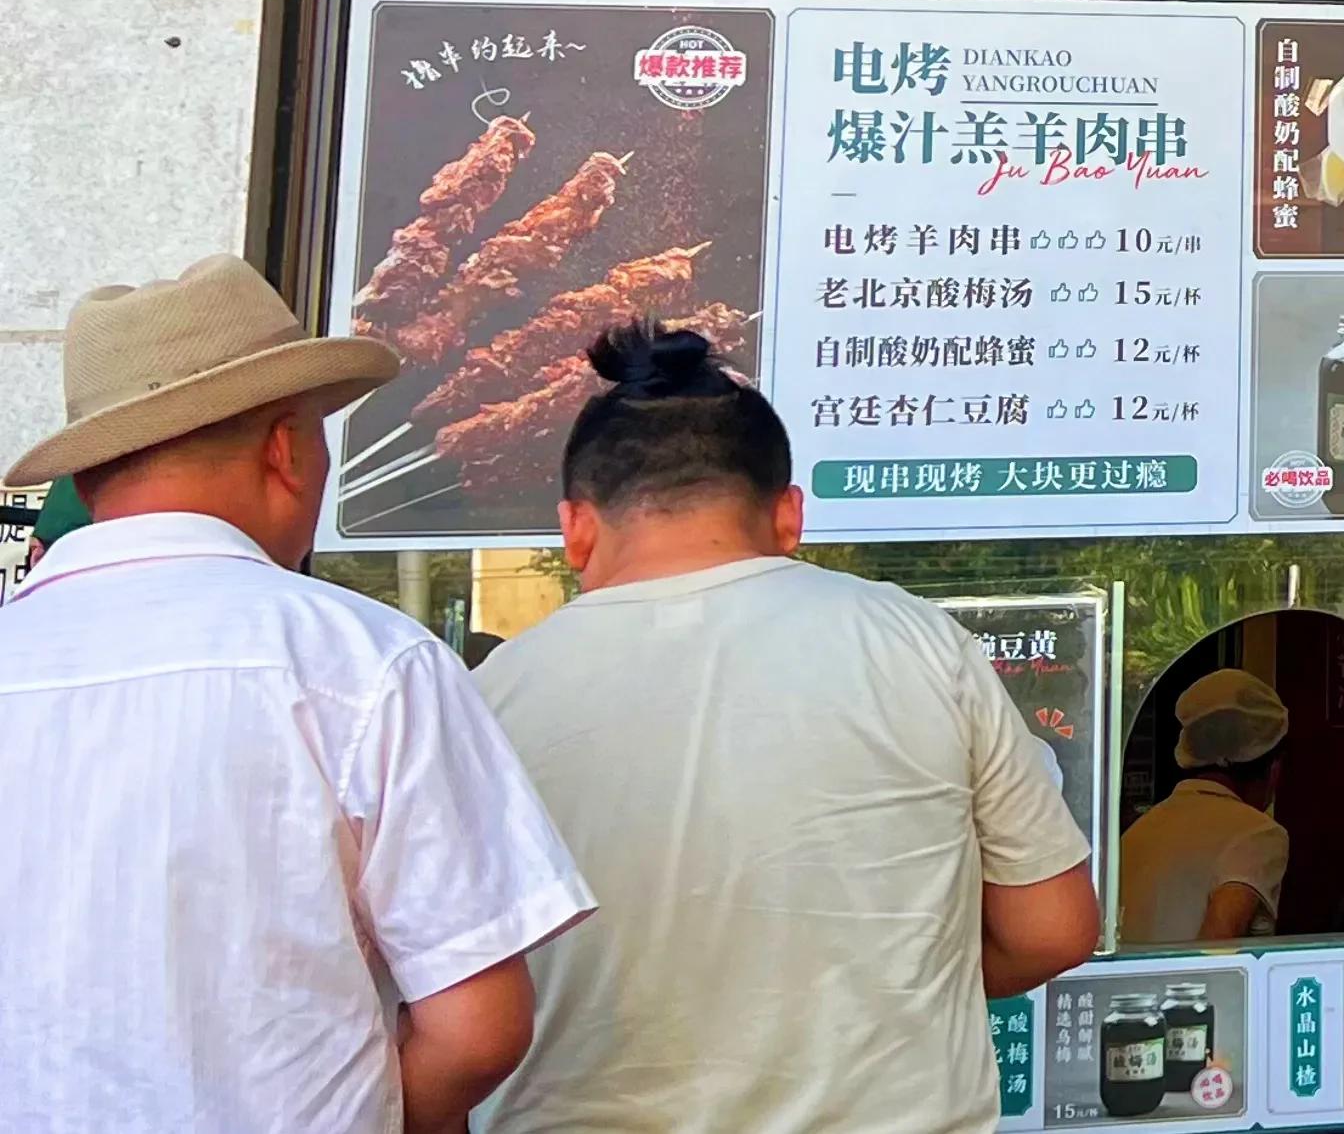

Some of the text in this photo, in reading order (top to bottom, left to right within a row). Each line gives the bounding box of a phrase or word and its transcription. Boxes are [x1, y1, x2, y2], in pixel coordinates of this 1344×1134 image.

[638, 54, 744, 80] 爆款推荐
[833, 41, 952, 96] 电烤
[963, 48, 1073, 67] DIANKAO
[962, 74, 1160, 95] YANGROUCHUAN
[826, 109, 1188, 165] 爆汁羔羊肉串
[1271, 38, 1301, 230] 自制酸奶配蜂蜜
[977, 149, 1209, 196] Ju Bao Yuan
[823, 224, 1202, 256] 电烤羊肉串 10元/串
[815, 277, 1202, 309] 老北京酸梅汤 15元/杯
[815, 335, 1201, 368] 自制酸奶配蜂蜜 12元/杯
[810, 393, 1200, 428] 宫廷杏仁豆腐 12元/杯
[842, 458, 1168, 495] 现串现烤 大块更过瘾
[1264, 470, 1331, 487] 必喝饮品
[1296, 986, 1317, 1086] 水晶山楂
[1006, 1013, 1029, 1095] 酸梅汤
